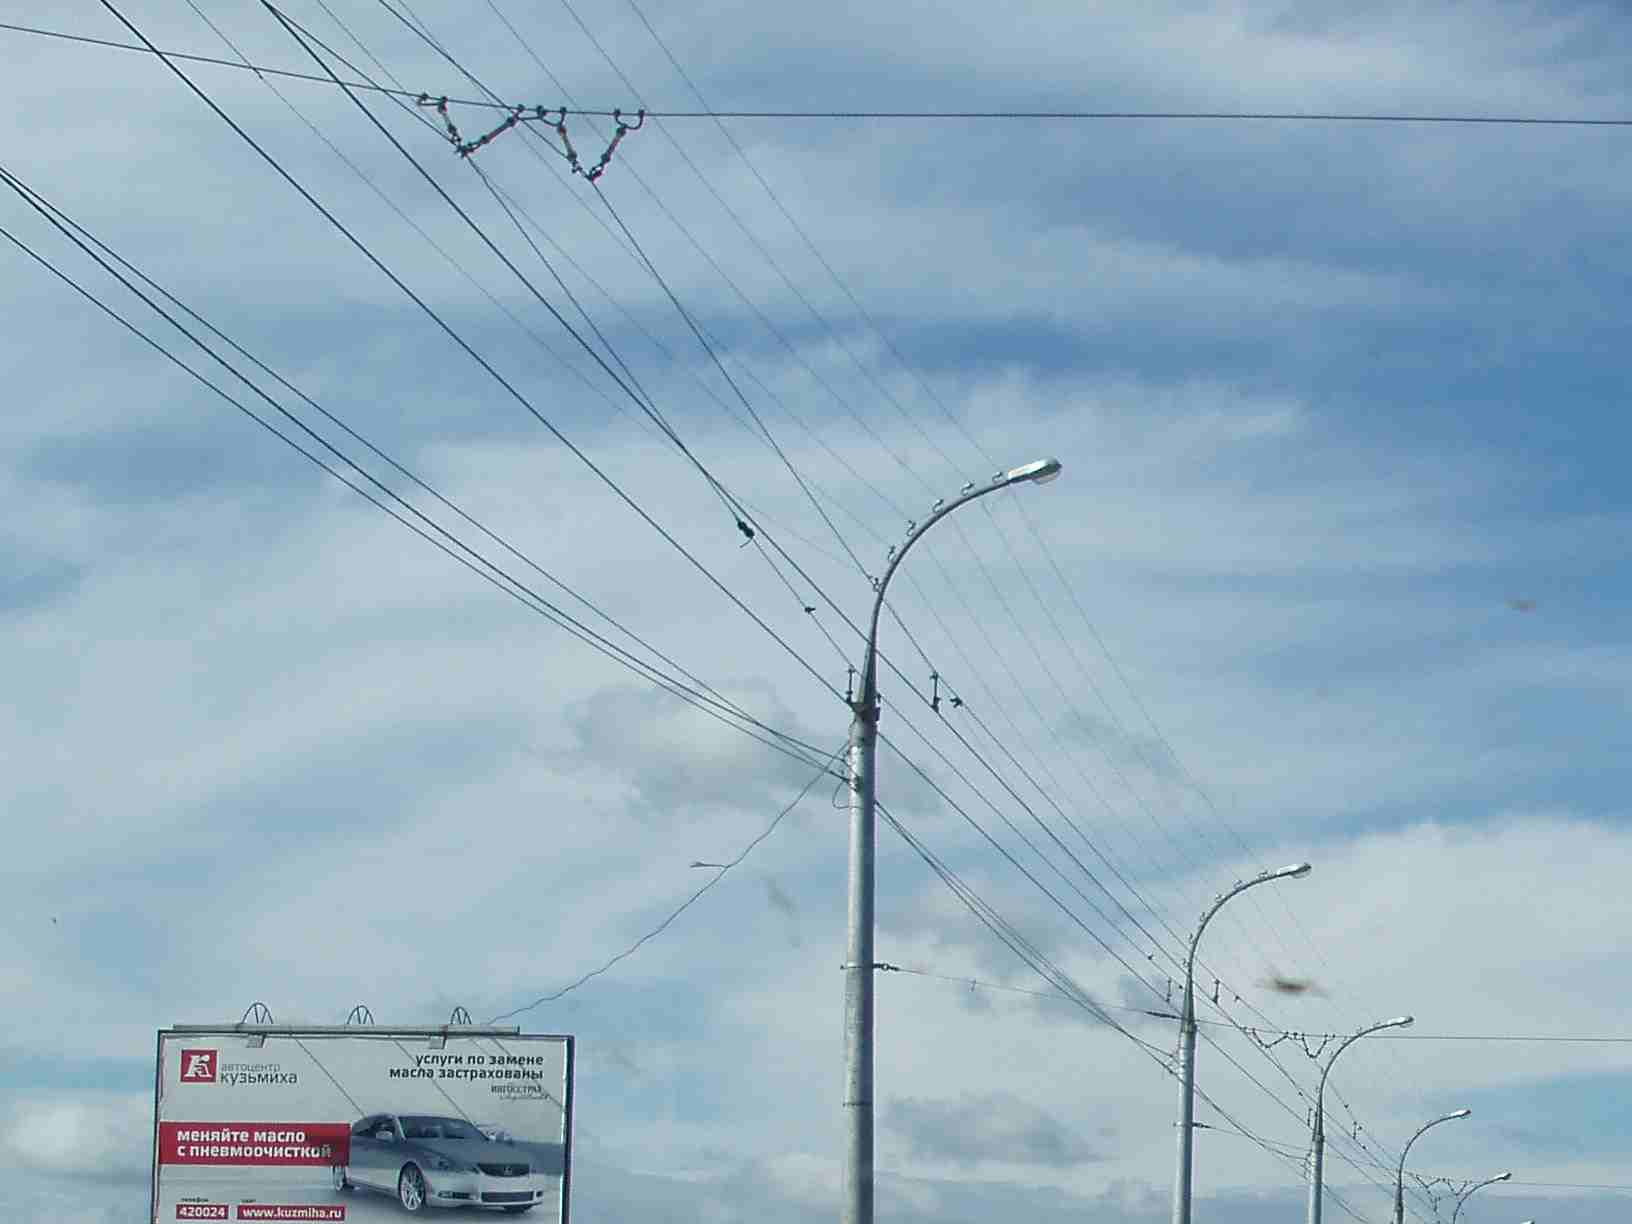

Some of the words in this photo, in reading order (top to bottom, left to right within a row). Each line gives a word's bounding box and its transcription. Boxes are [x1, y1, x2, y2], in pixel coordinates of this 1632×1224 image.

[415, 1054, 463, 1067] услуги
[467, 1055, 485, 1065] по
[489, 1055, 544, 1066] замене
[220, 1072, 298, 1086] кузьмиха
[389, 1068, 434, 1079] масла
[438, 1069, 543, 1081] застрахованы
[176, 1128, 249, 1143] меняйте
[253, 1130, 305, 1143] масло
[177, 1146, 186, 1157] с
[189, 1144, 332, 1159] пневмоочисткой
[178, 1206, 226, 1218] 420024
[242, 1206, 343, 1219] www.kuzmiha.ru
